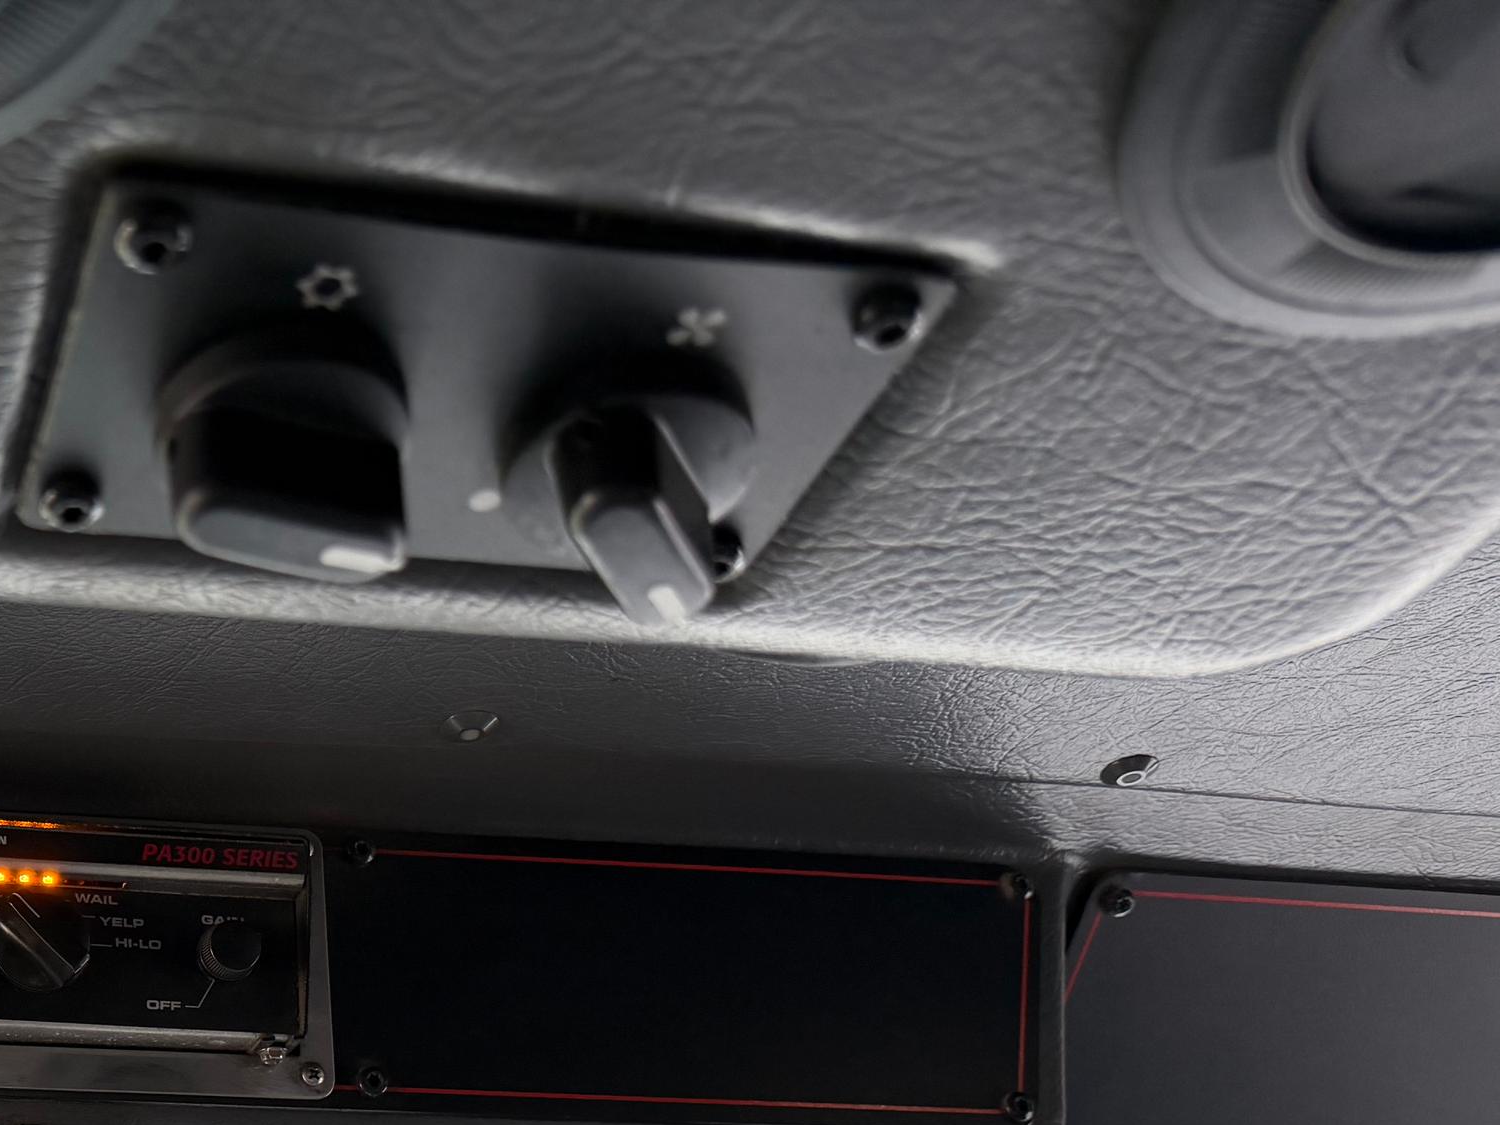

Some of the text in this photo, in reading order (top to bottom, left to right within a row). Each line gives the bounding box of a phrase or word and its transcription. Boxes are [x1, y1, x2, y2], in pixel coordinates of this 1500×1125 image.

[141, 843, 299, 870] PA300 SERIES
[75, 893, 119, 905] WAIL
[100, 916, 144, 928] YELP
[201, 914, 245, 925] GA
[115, 938, 162, 950] HI-LO
[146, 1000, 182, 1011] OFF
